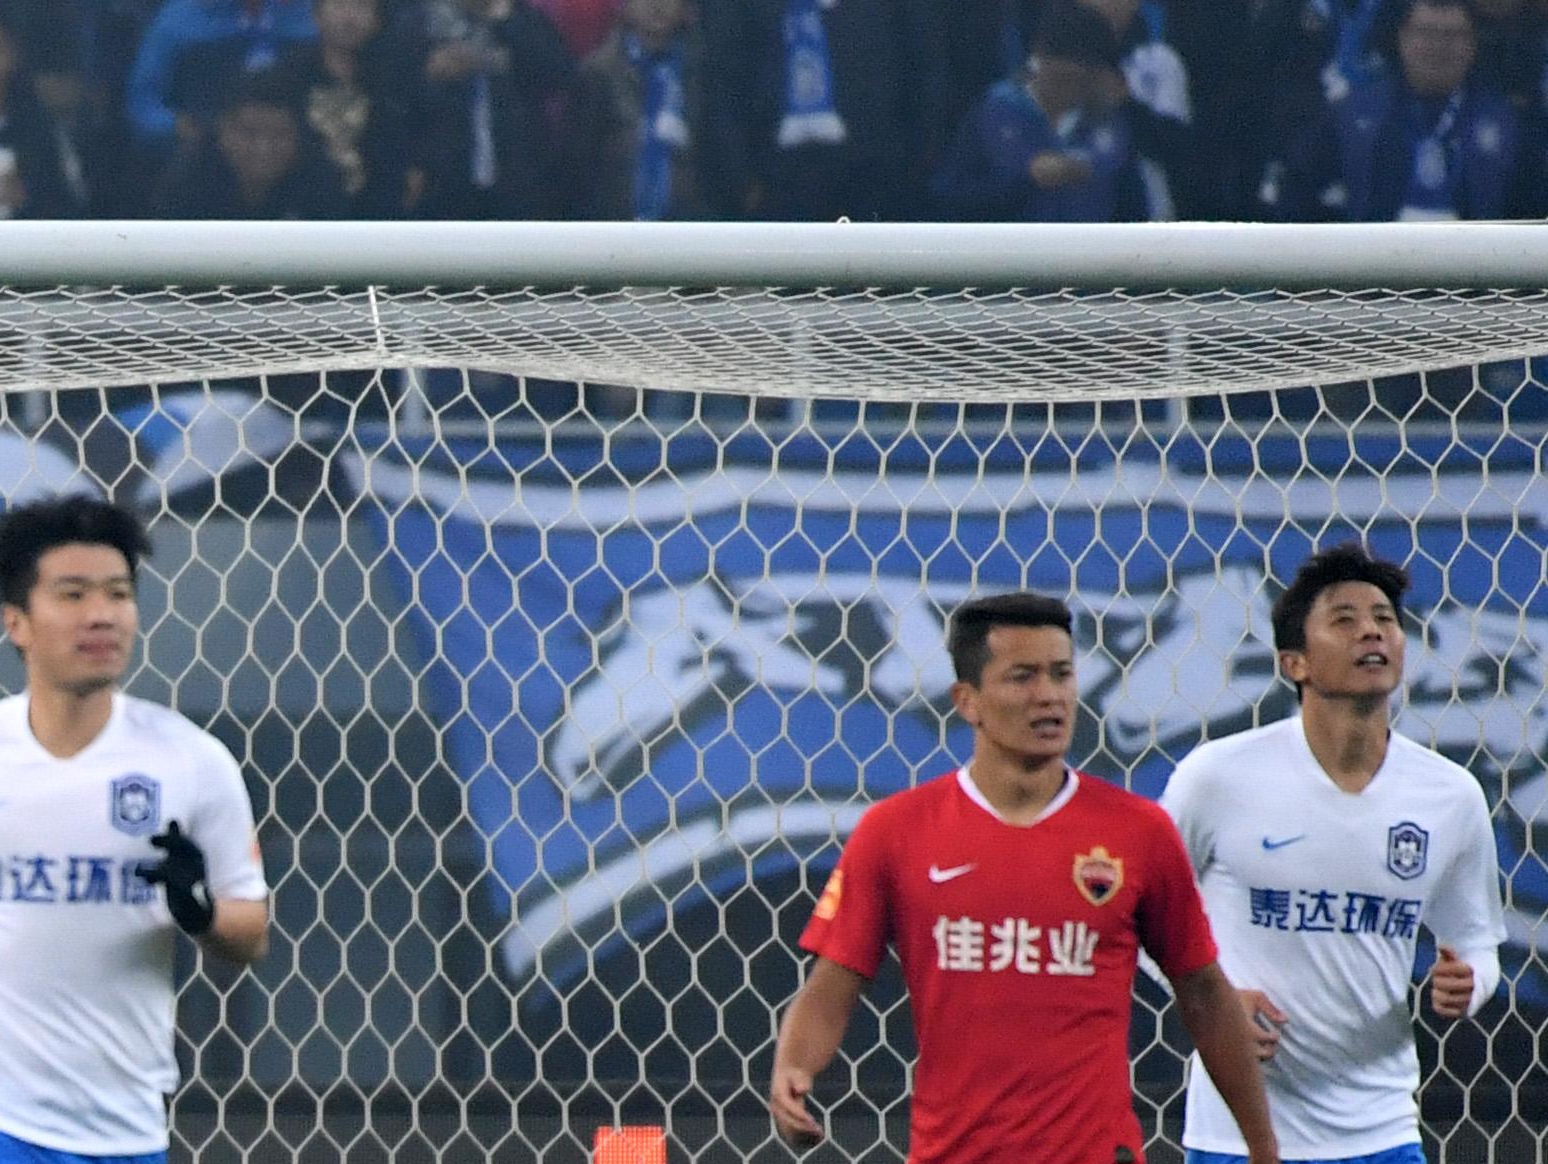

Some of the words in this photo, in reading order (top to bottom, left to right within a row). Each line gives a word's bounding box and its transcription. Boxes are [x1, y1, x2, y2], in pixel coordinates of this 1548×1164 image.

[1249, 886, 1422, 939] 泰达环保
[932, 917, 1098, 976] 佳兆业
